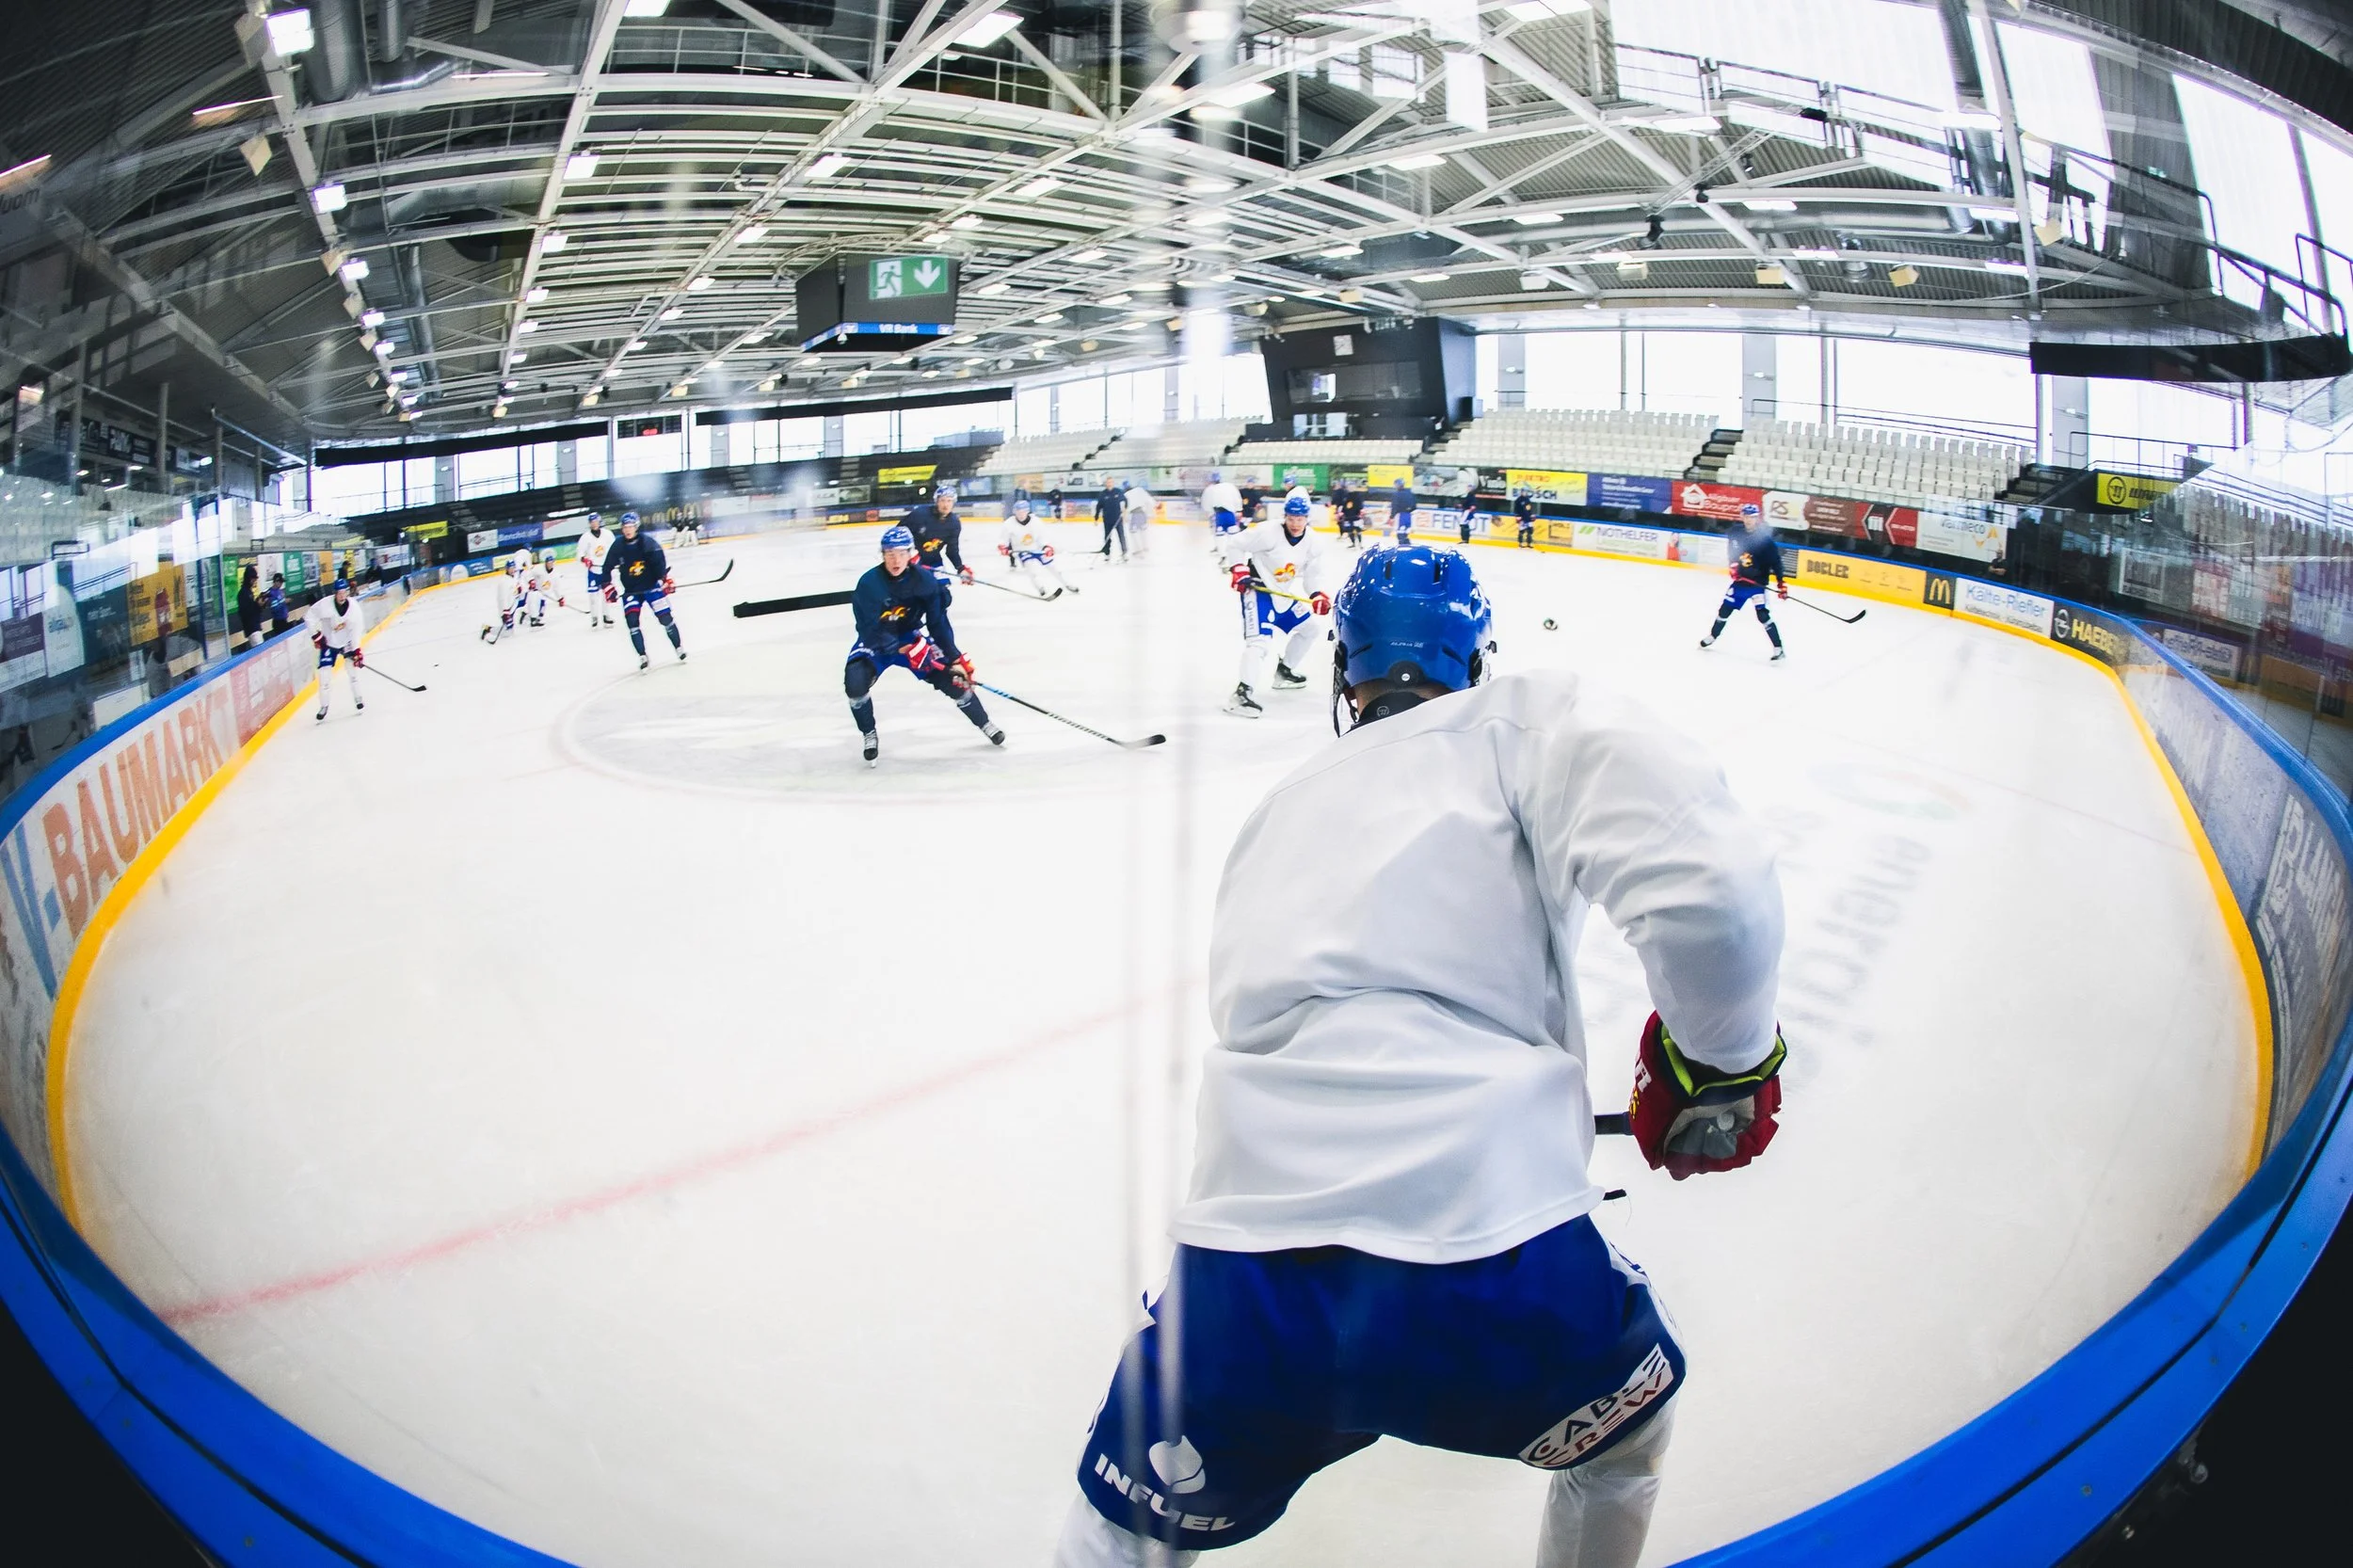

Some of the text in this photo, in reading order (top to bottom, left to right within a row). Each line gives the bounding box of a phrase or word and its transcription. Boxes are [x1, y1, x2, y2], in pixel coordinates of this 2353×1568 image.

[1433, 513, 1489, 533] FENT
[1597, 526, 1657, 542] NOTHELFER
[1528, 1350, 1666, 1461] CABIN
[1543, 1371, 1662, 1466] CREW
[1095, 1453, 1236, 1531] INFUEL
